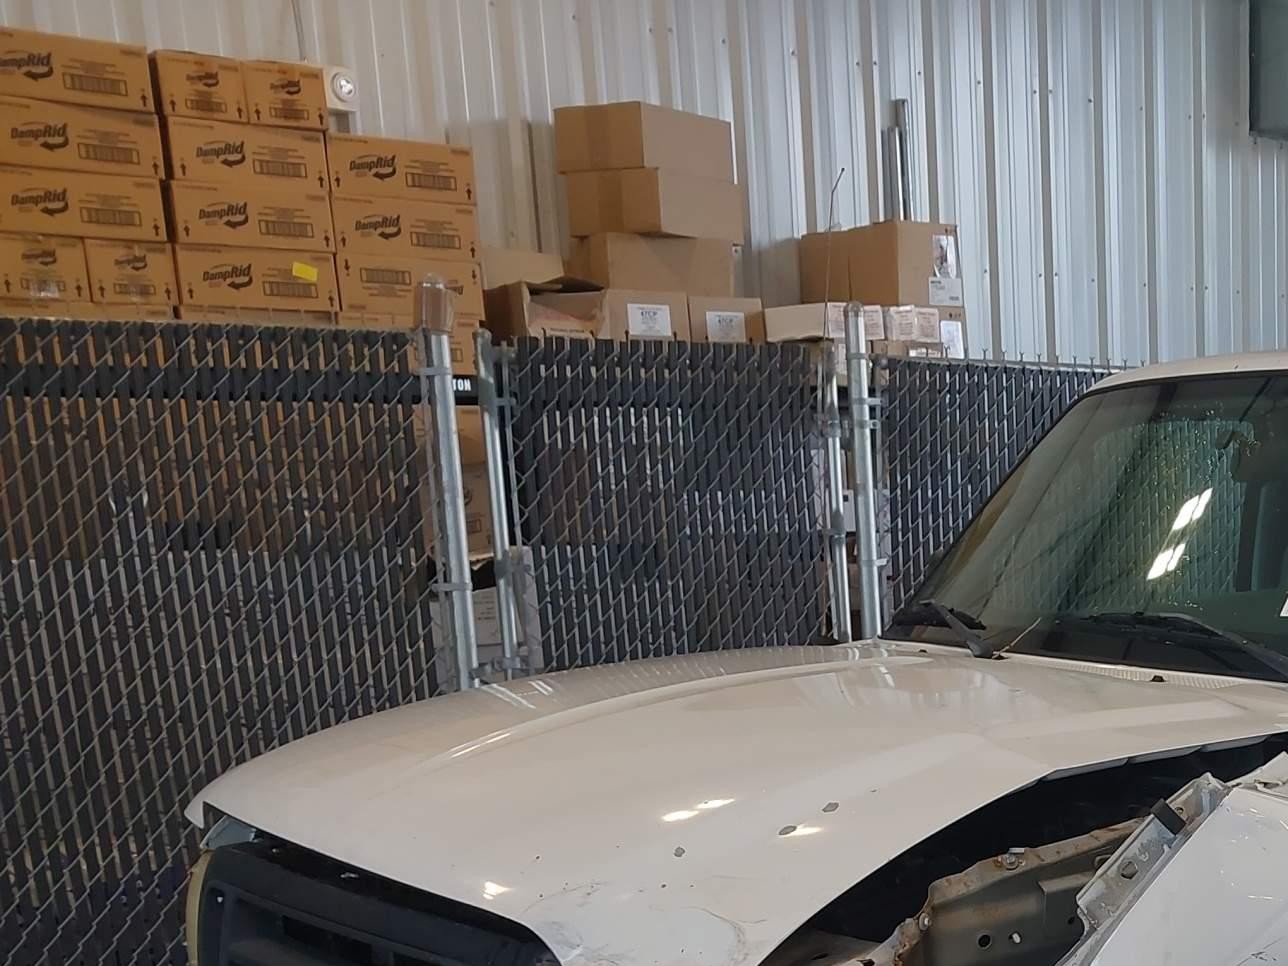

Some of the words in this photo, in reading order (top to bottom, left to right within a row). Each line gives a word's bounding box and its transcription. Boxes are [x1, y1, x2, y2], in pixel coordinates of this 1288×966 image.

[0, 52, 52, 69] ampRid
[11, 122, 67, 141] DampRid
[196, 141, 245, 159] DampRid
[350, 155, 396, 172] DampRid
[11, 187, 67, 206] DampRid
[199, 202, 247, 219] DampRid
[355, 214, 400, 231] DampRid
[203, 264, 251, 282] DampRid
